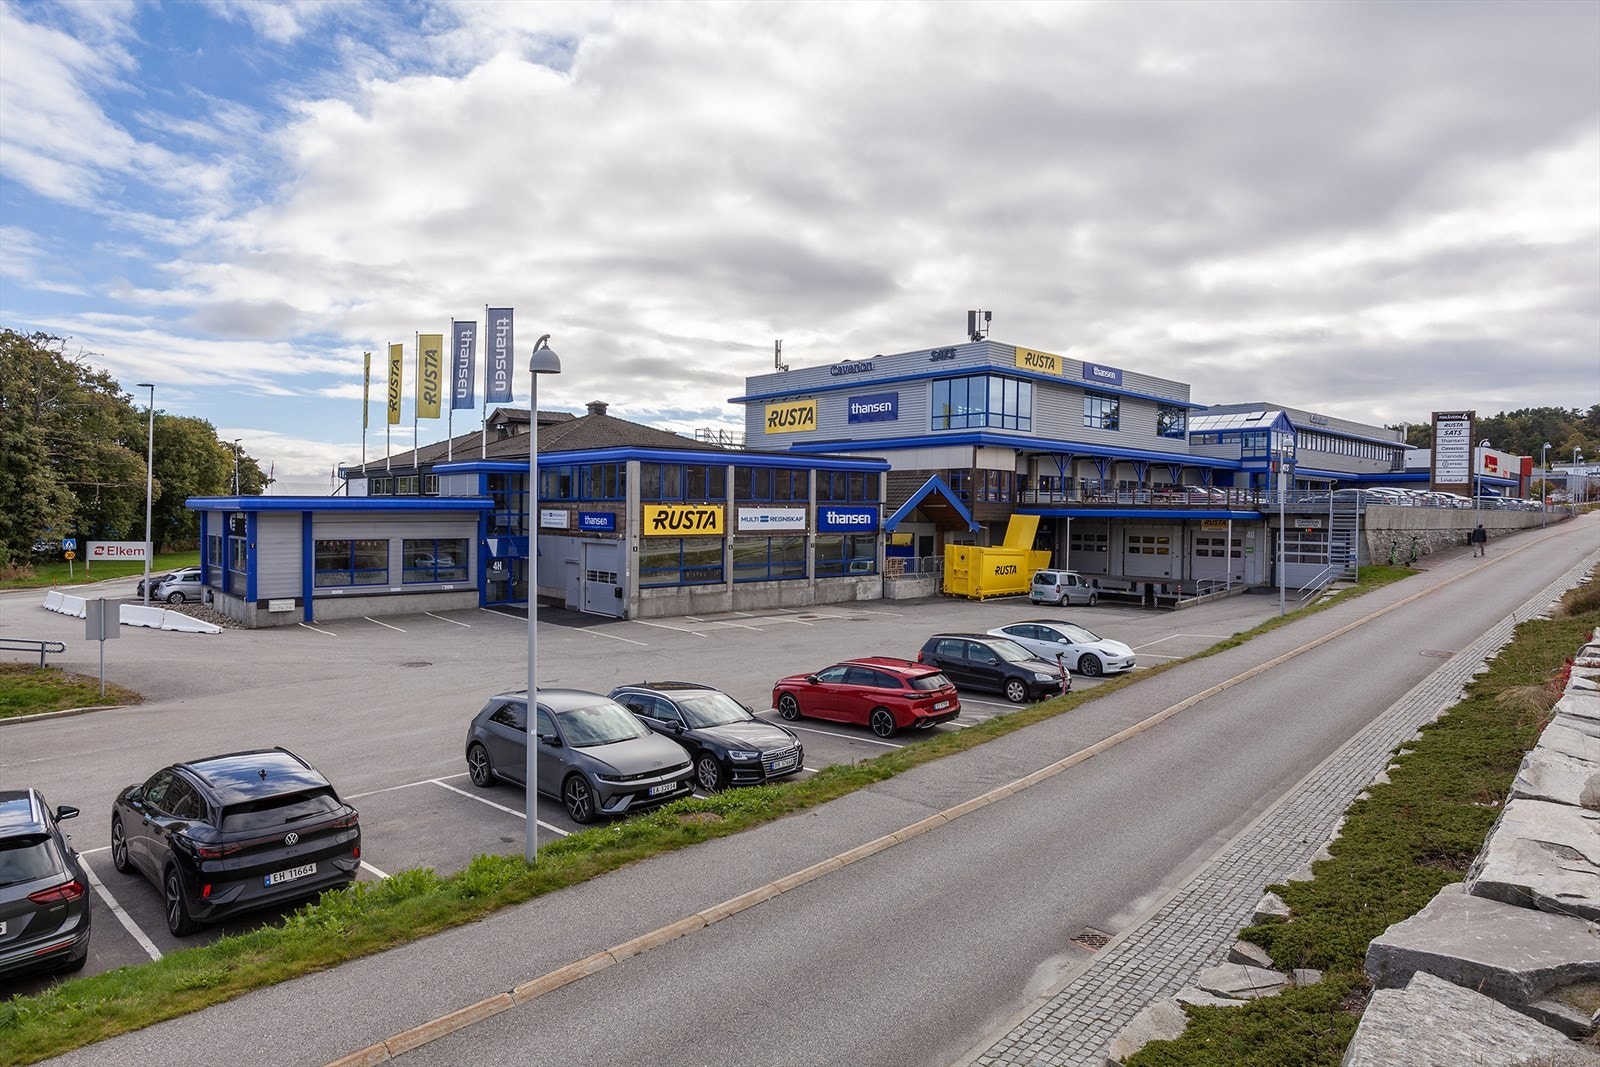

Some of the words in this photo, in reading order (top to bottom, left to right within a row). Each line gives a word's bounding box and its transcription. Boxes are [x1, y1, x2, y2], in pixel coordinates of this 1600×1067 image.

[495, 317, 509, 391] thansen
[929, 349, 957, 361] SATS
[1025, 352, 1055, 370] RUSTA
[457, 330, 472, 398] thansen
[830, 361, 875, 376] Caverion
[424, 349, 438, 405] RUSTA
[1093, 366, 1116, 379] thansen
[389, 359, 400, 412] RUSTA
[851, 402, 892, 414] thansen
[768, 406, 814, 428] RUSTA
[584, 516, 607, 525] thansen
[653, 511, 716, 529] RUSTA
[770, 515, 803, 523] REGNSKAP
[826, 511, 871, 525] thansen
[107, 546, 145, 555] Elkem
[493, 561, 502, 570] 4H
[995, 565, 1017, 575] RUSTA
[273, 873, 285, 882] EH
[289, 865, 314, 878] 11664
